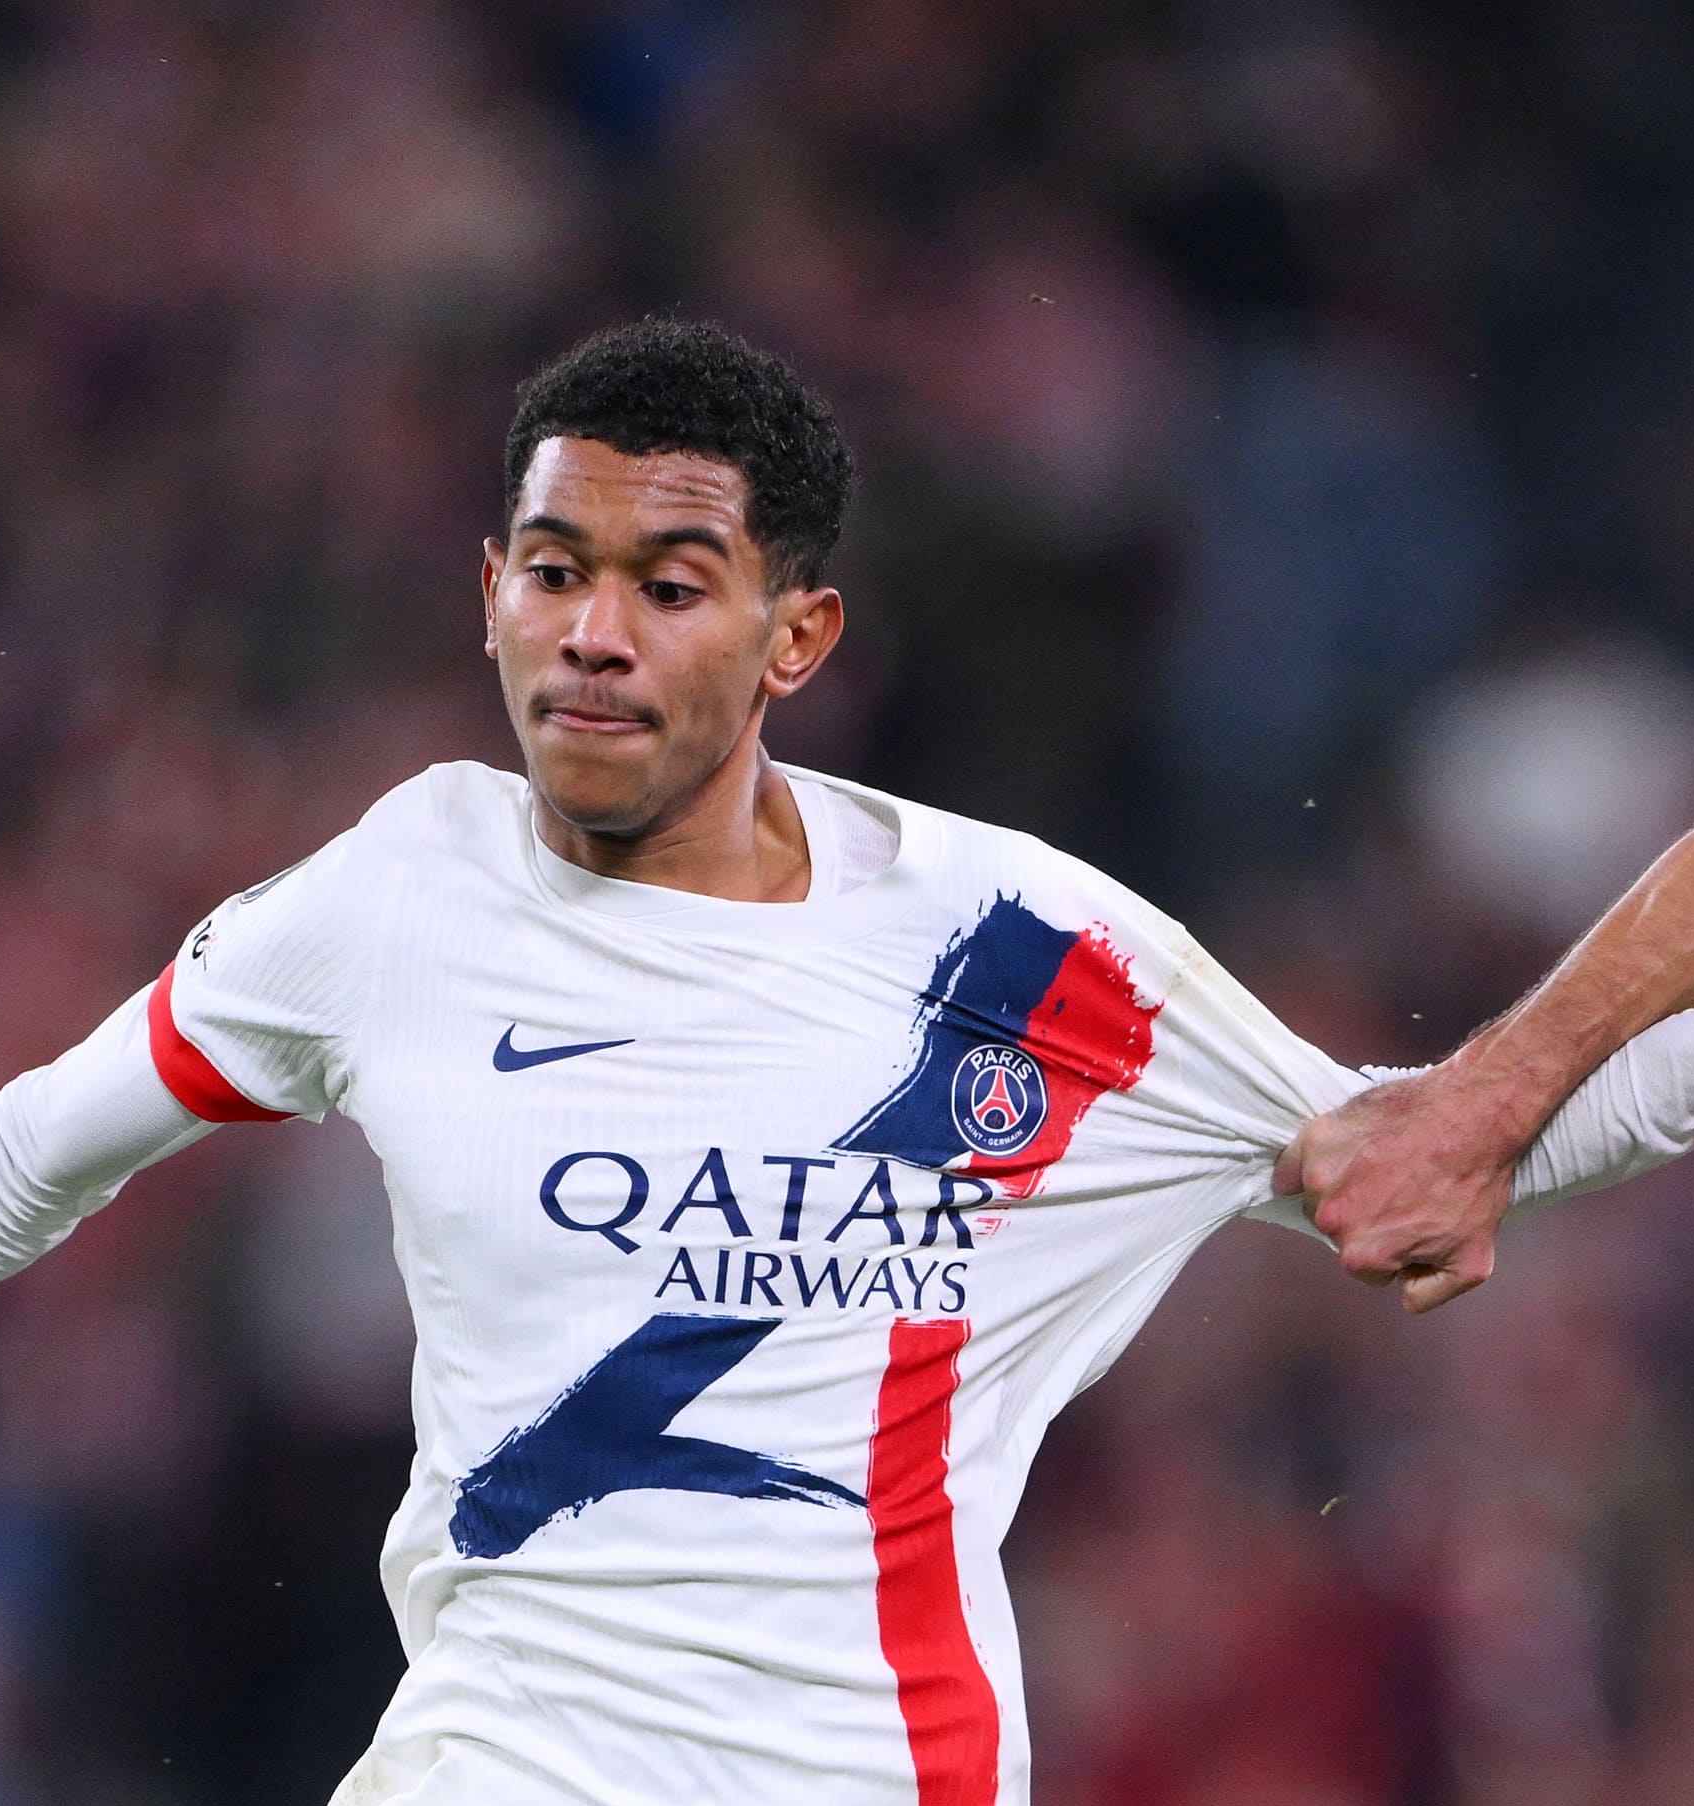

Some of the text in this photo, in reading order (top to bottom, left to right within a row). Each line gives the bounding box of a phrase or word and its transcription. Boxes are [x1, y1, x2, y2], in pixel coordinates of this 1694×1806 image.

[970, 1049, 1033, 1081] PARIS
[539, 1147, 993, 1255] QATAR
[654, 1247, 968, 1313] AIRWAYS
